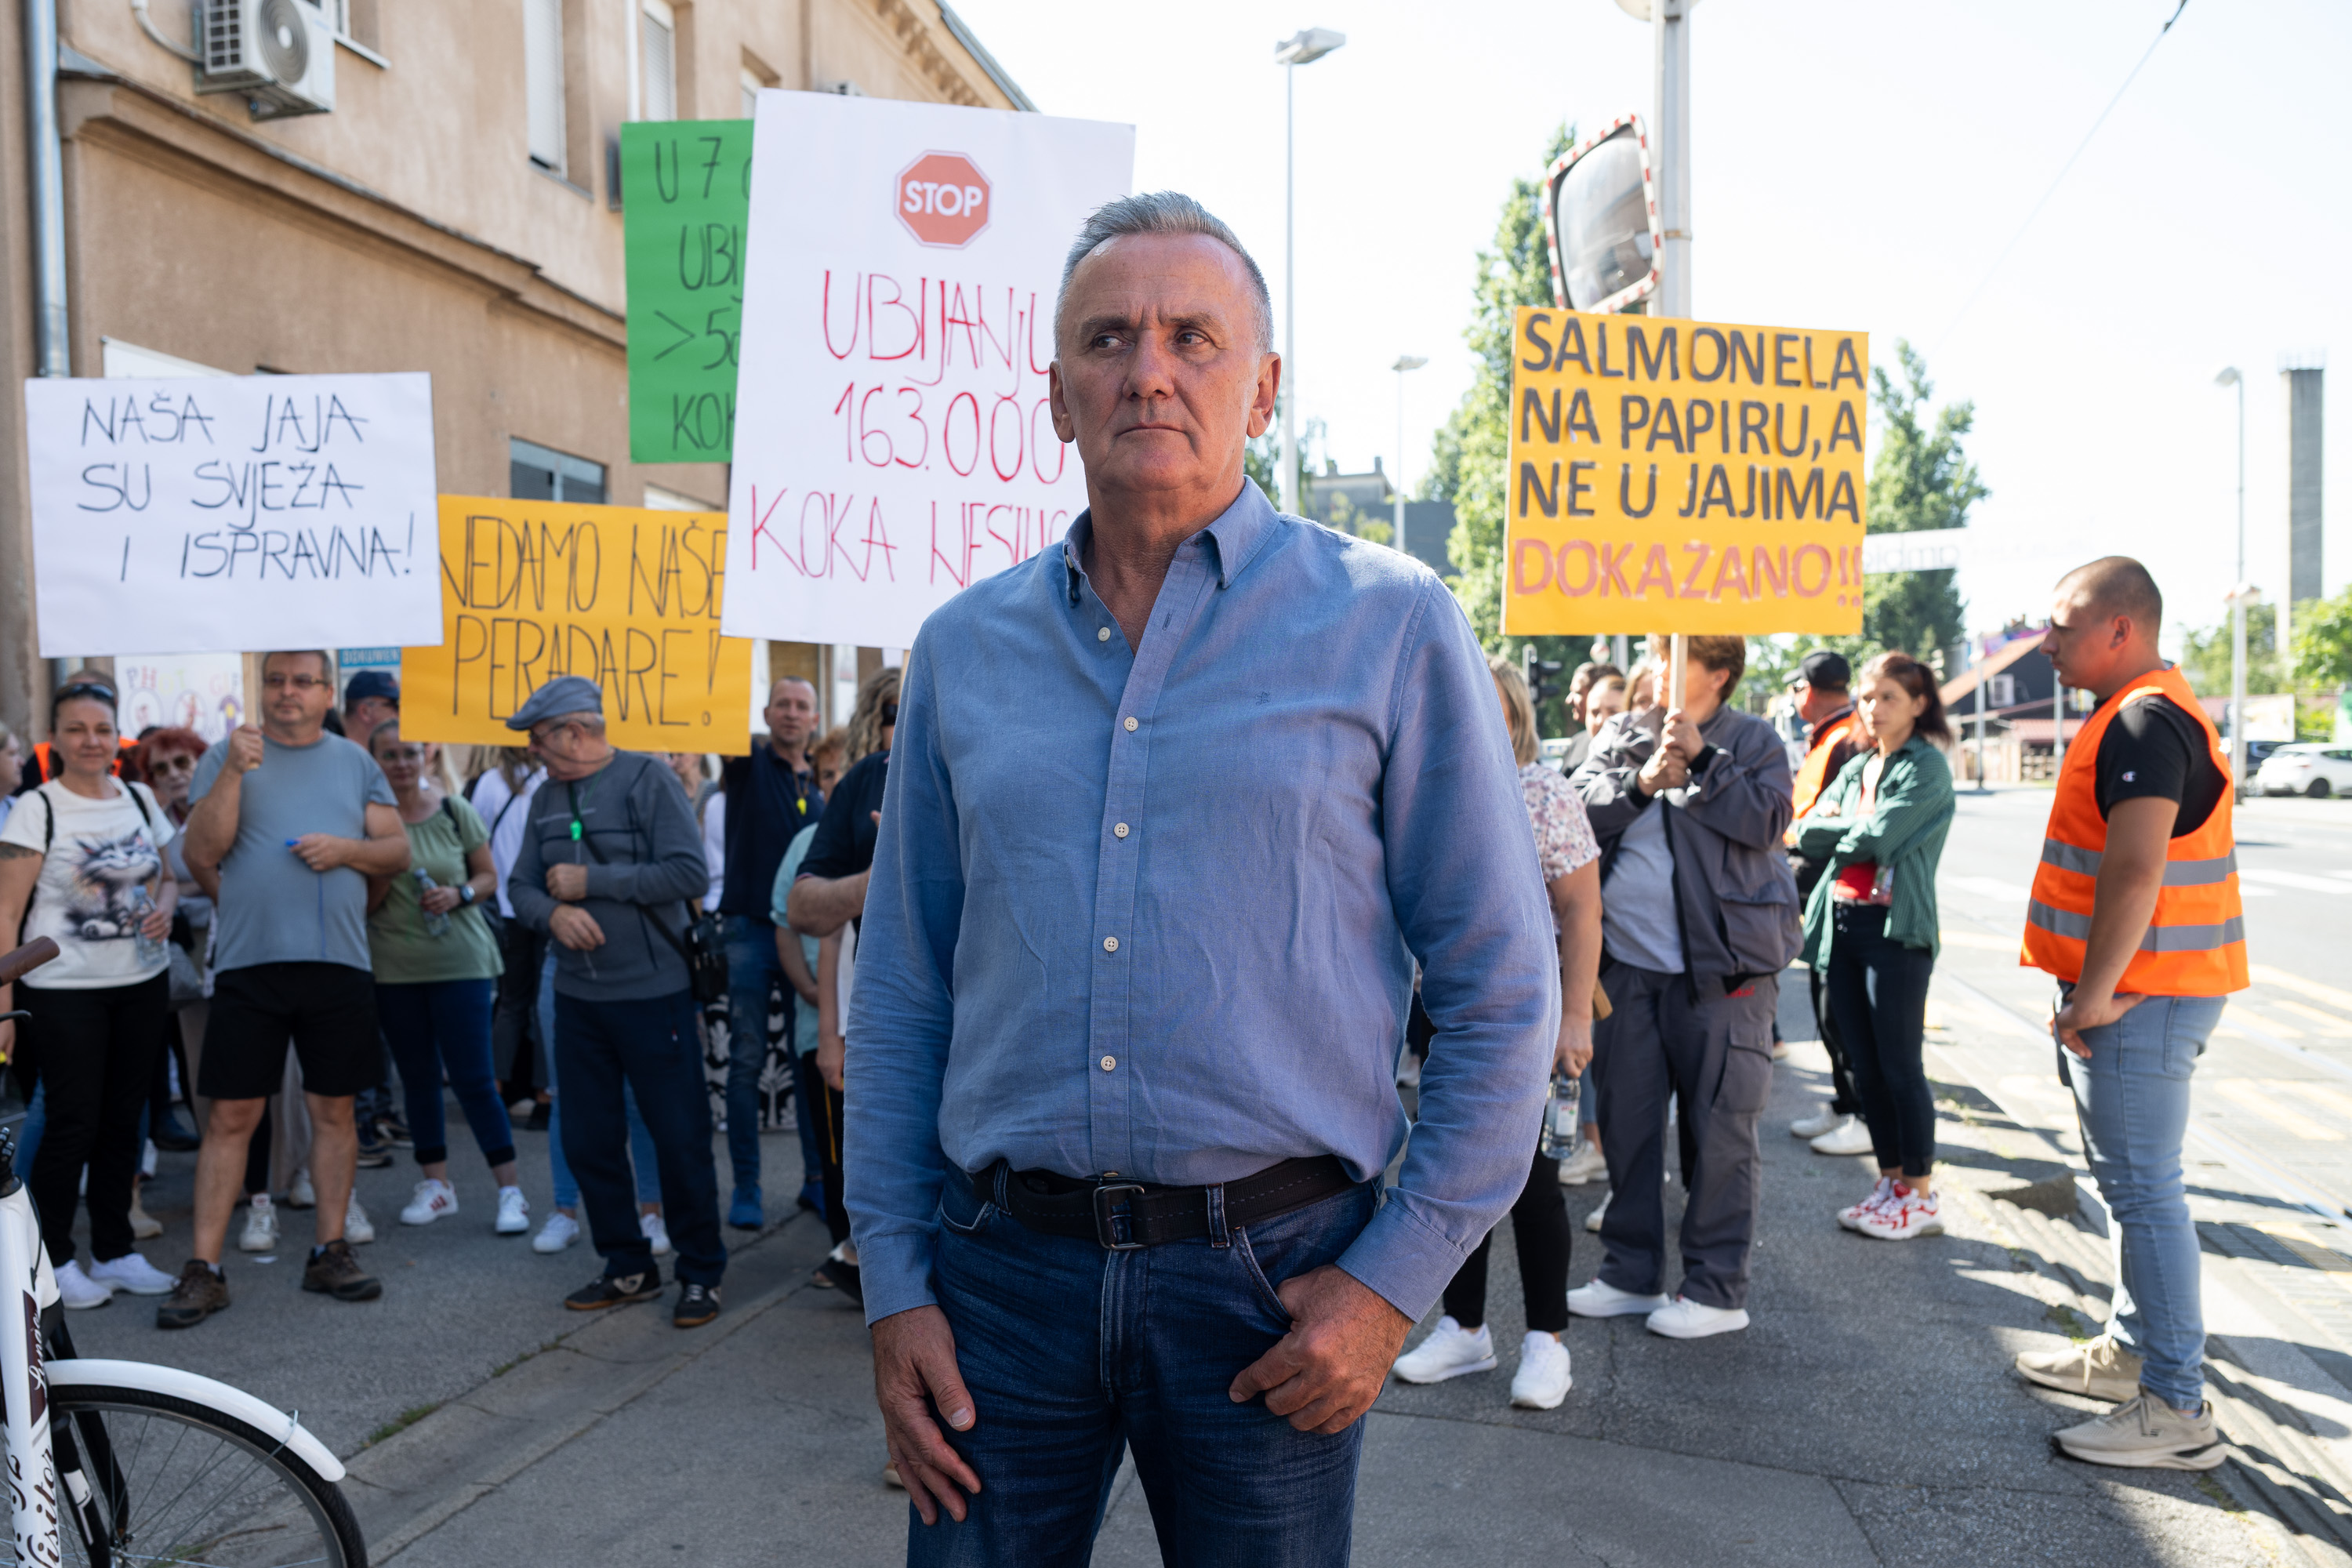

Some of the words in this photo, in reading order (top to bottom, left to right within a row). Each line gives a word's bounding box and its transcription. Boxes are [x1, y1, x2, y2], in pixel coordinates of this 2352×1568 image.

[655, 140, 679, 204] U
[699, 136, 722, 199] 7
[903, 180, 983, 217] STOP
[679, 223, 742, 303] UBI
[1523, 313, 1865, 390] SALMONELA
[82, 390, 215, 447] NAŠA
[251, 393, 370, 452] JAJA
[835, 381, 1065, 485] 163.000
[1521, 387, 1601, 444] NA
[76, 463, 151, 512] SU
[191, 459, 365, 531] SVJEŽA
[1519, 461, 1595, 518] NE
[1620, 463, 1657, 518] U
[1678, 463, 1861, 524] JAJIMA
[121, 535, 130, 582] I
[180, 511, 415, 580] ISPRAVNA!
[630, 519, 728, 619] NAŠE
[751, 484, 898, 583] KOKA
